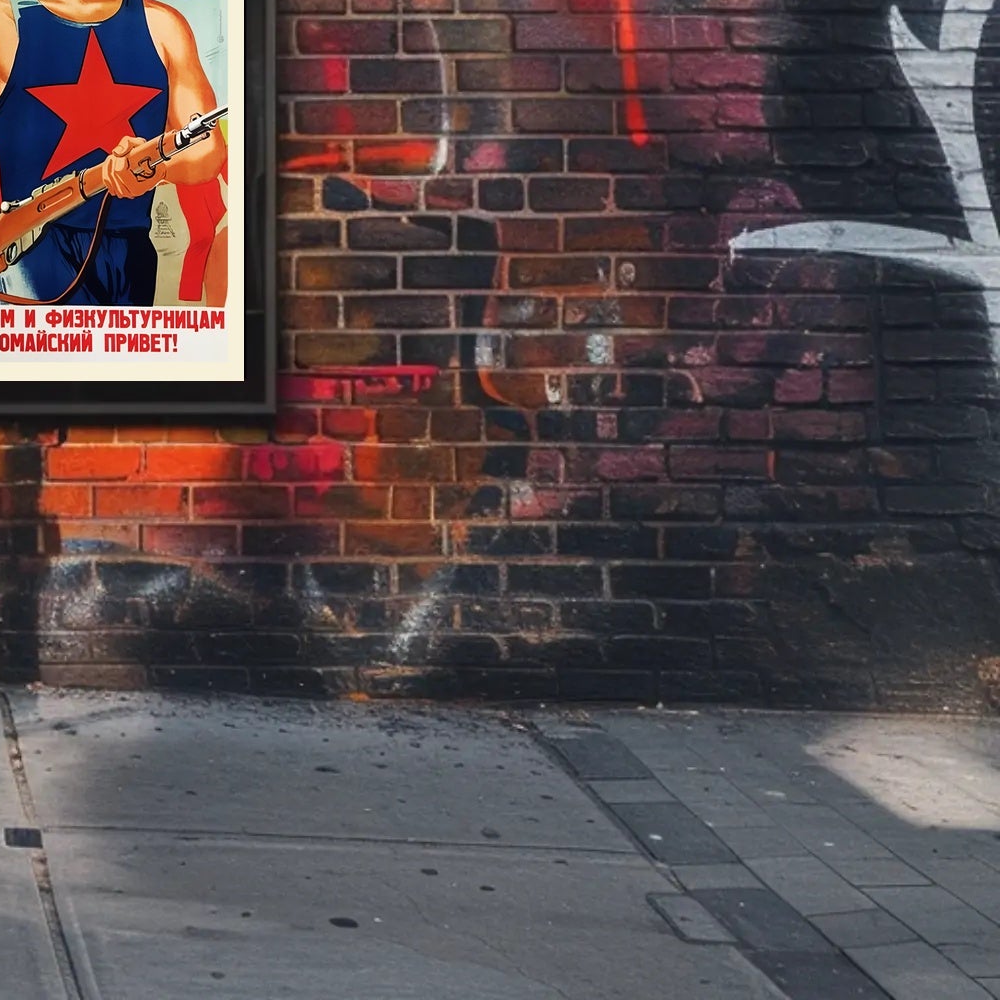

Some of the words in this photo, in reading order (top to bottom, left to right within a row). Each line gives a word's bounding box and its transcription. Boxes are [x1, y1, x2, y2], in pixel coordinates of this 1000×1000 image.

[24, 309, 36, 329] И
[45, 309, 226, 332] ФИЗКУЛЬТУРНИЦАМ
[103, 333, 179, 353] ПРИВЕТ!
